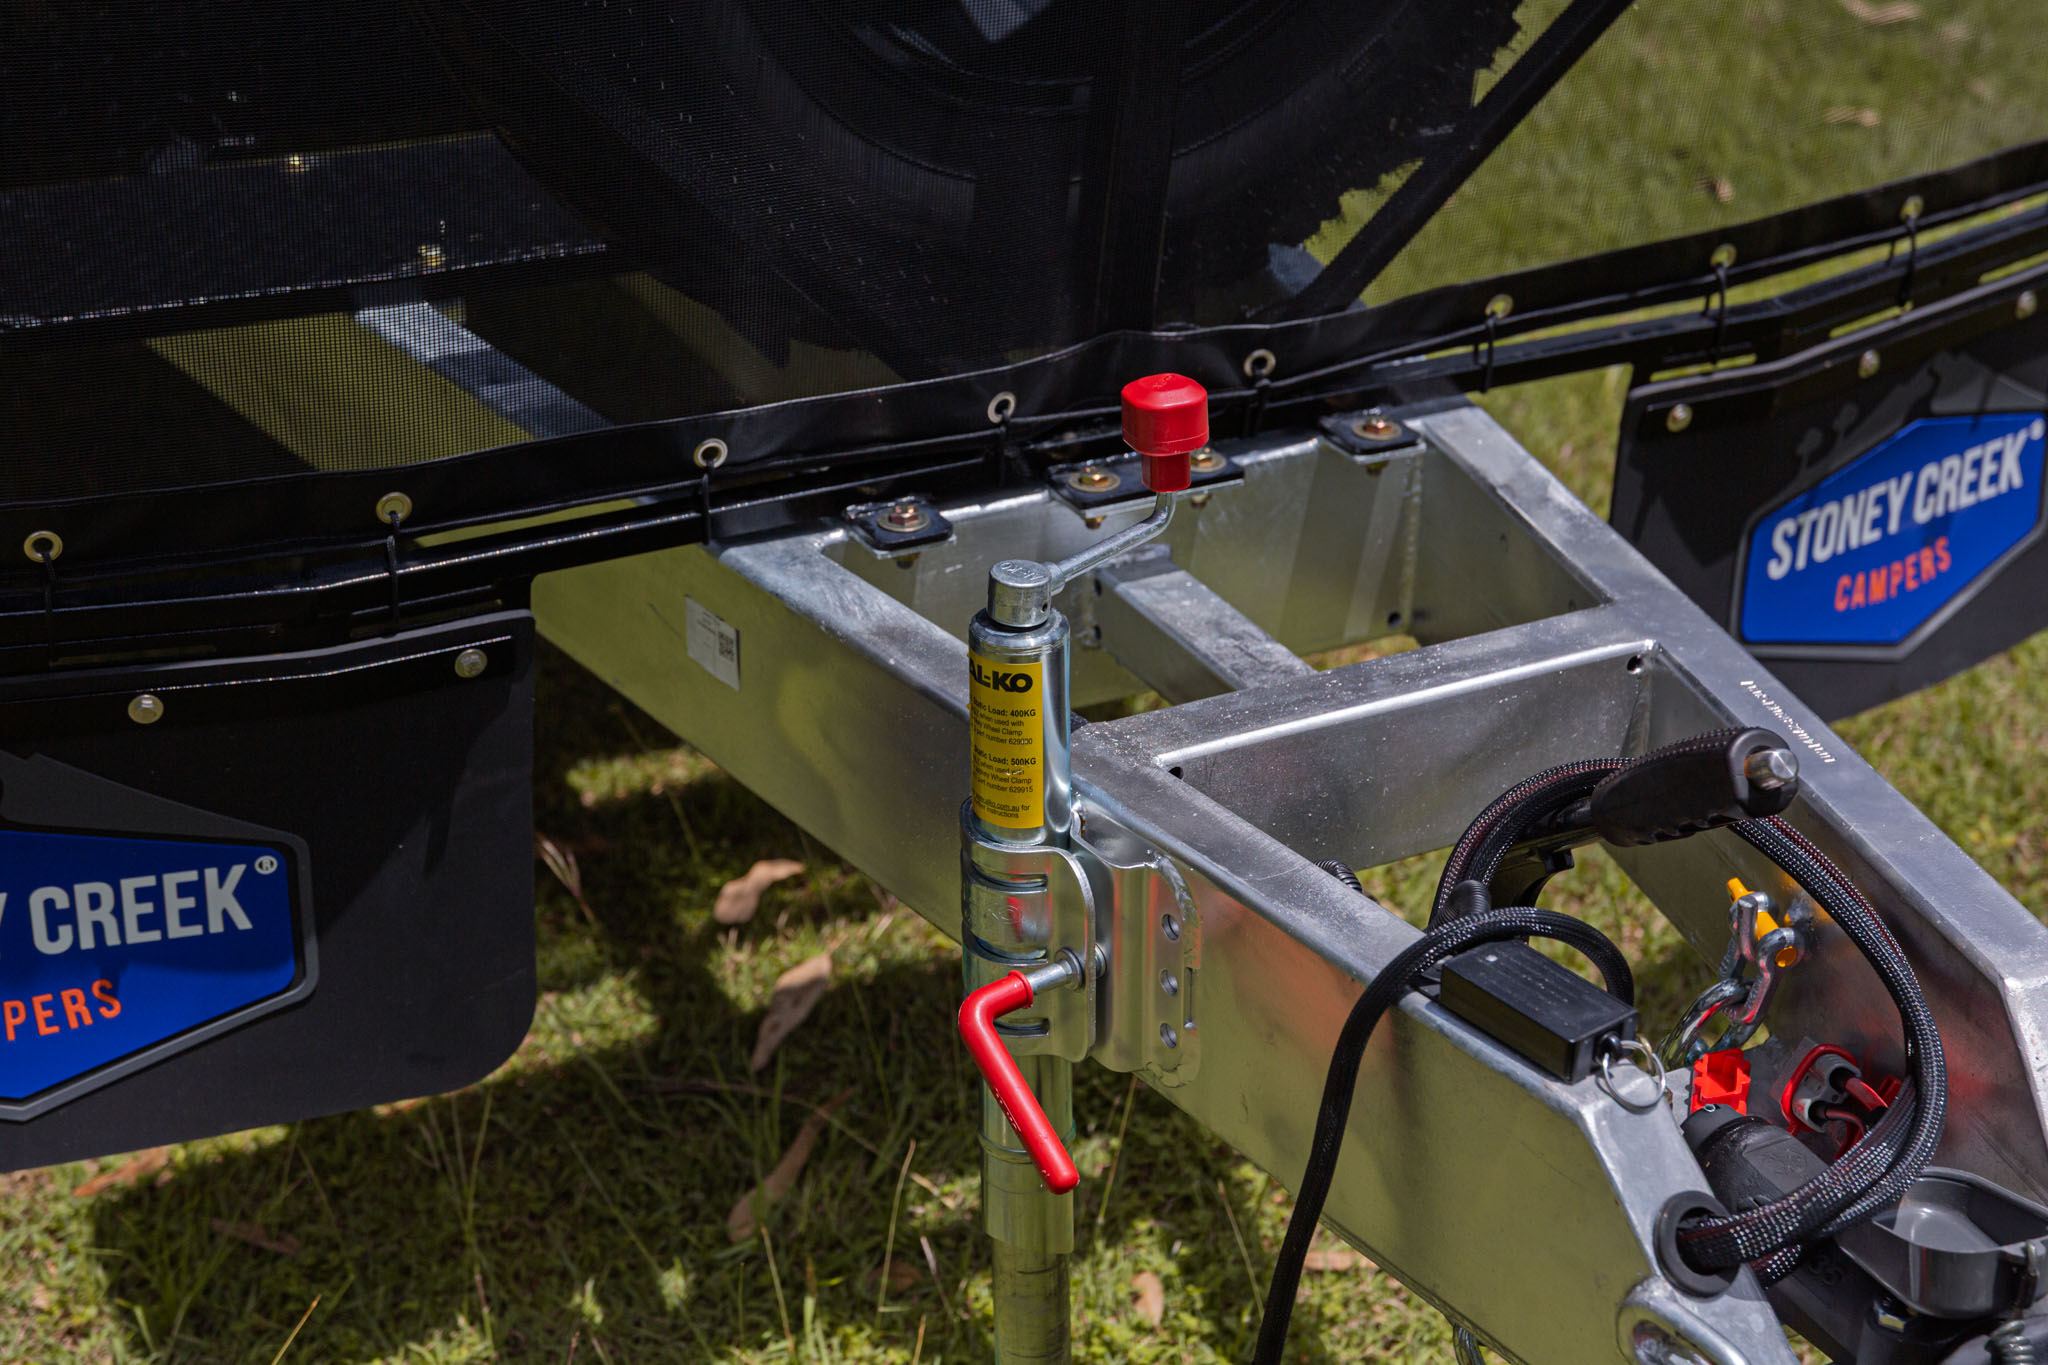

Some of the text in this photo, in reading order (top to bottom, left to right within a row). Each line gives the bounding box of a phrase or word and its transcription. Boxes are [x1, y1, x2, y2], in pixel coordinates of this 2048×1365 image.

[1767, 428, 2025, 580] STONEY CREEK
[1834, 536, 1951, 612] CAMPERS
[988, 704, 1008, 717] Load:
[1010, 709, 1036, 718] 400KG
[1002, 728, 1023, 736] Clamp
[989, 753, 1009, 765] Load:
[1011, 757, 1036, 766] 500KG
[991, 773, 1032, 785] Wheel Clamp
[1009, 785, 1033, 793] 629915
[29, 864, 253, 955] CREEK
